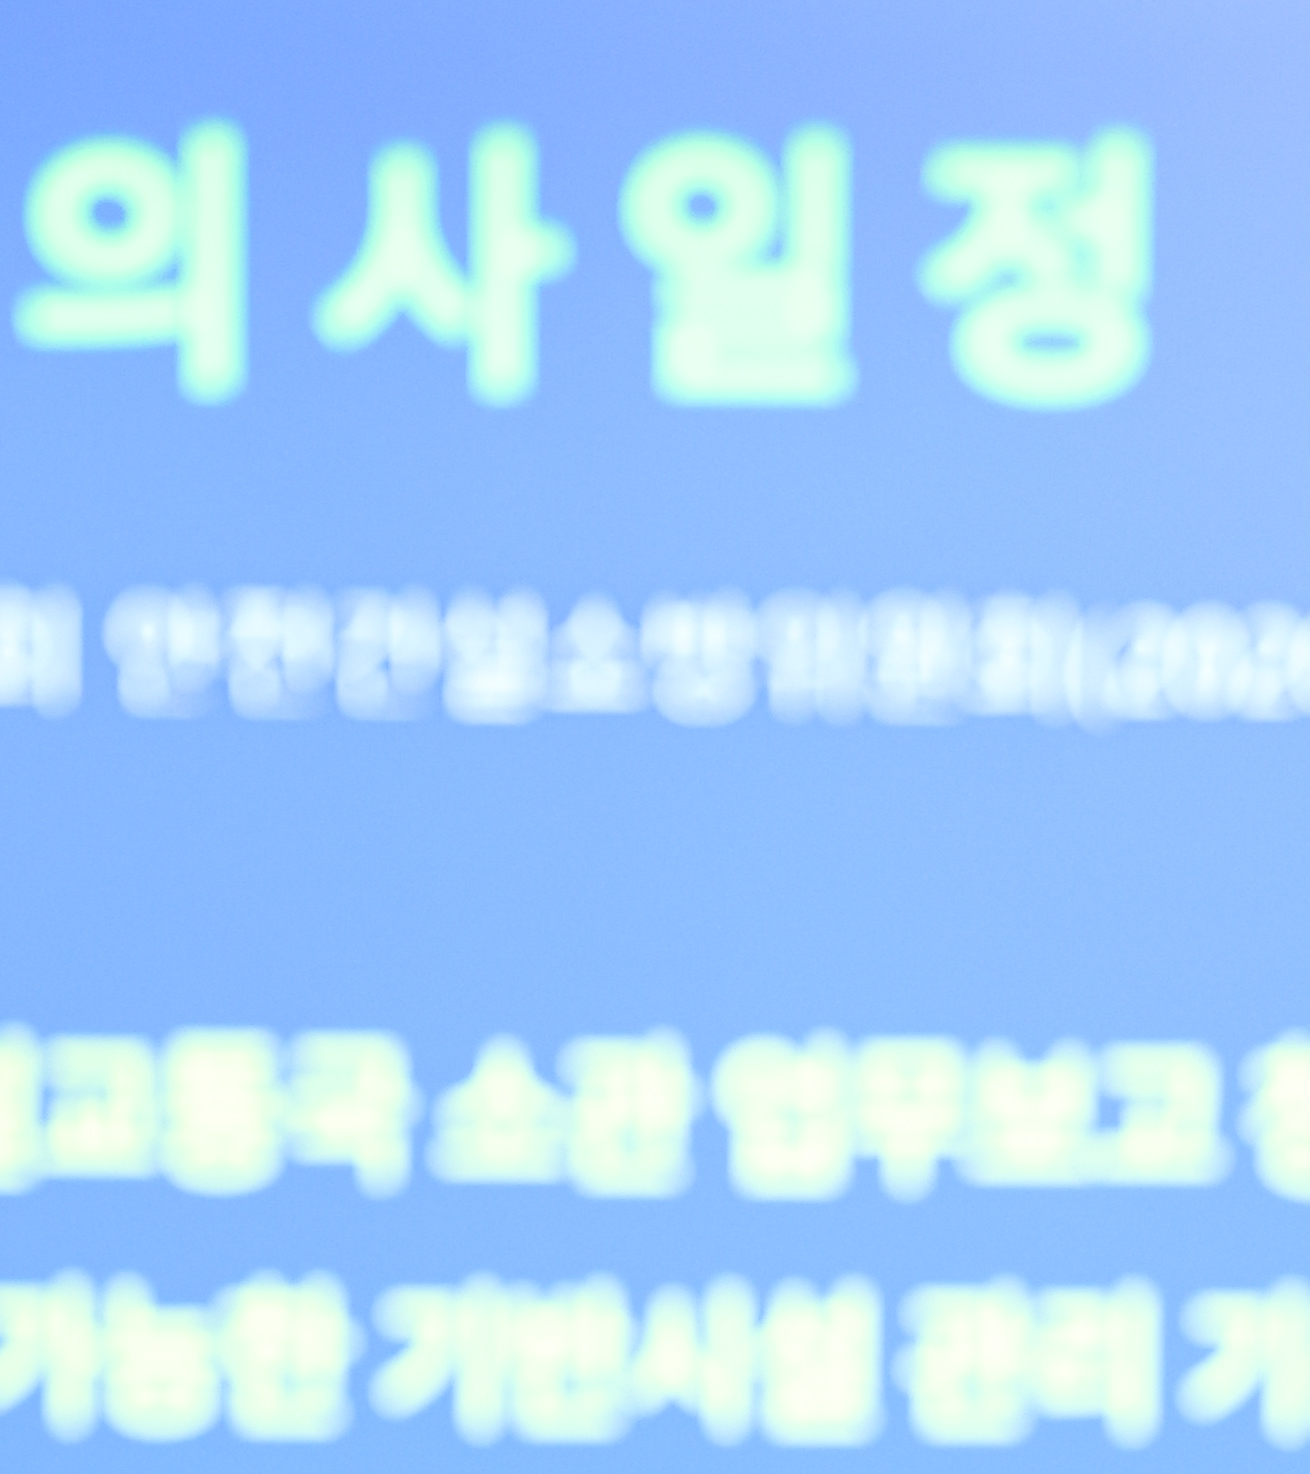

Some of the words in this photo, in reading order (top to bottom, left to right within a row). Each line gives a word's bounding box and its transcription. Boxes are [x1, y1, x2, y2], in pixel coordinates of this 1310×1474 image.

[431, 1031, 702, 1196] 소관
[709, 1031, 1229, 1199] 업무보고
[373, 1276, 882, 1445] 기반시설
[895, 1278, 1163, 1445] 관리
